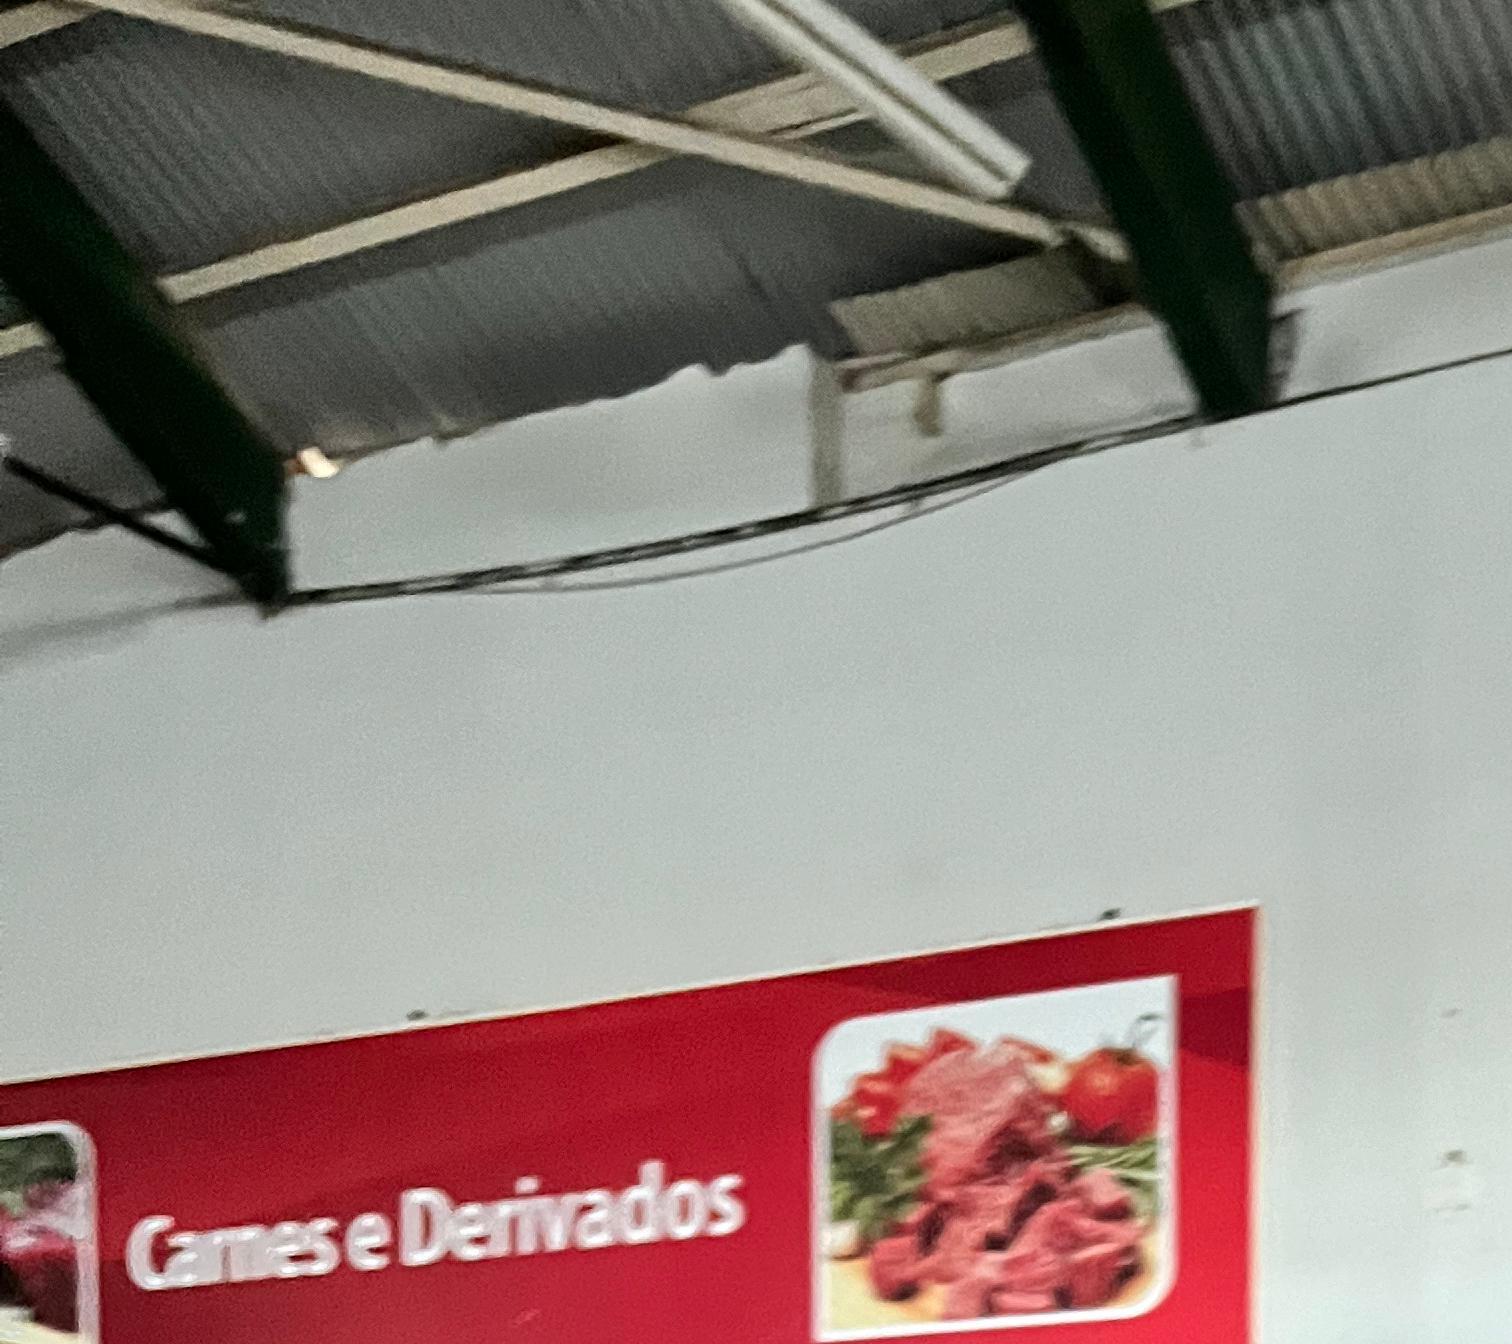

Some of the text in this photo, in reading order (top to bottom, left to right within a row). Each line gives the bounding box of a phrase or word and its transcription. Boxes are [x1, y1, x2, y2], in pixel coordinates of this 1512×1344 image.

[126, 1159, 745, 1291] Carnes e Derivados
